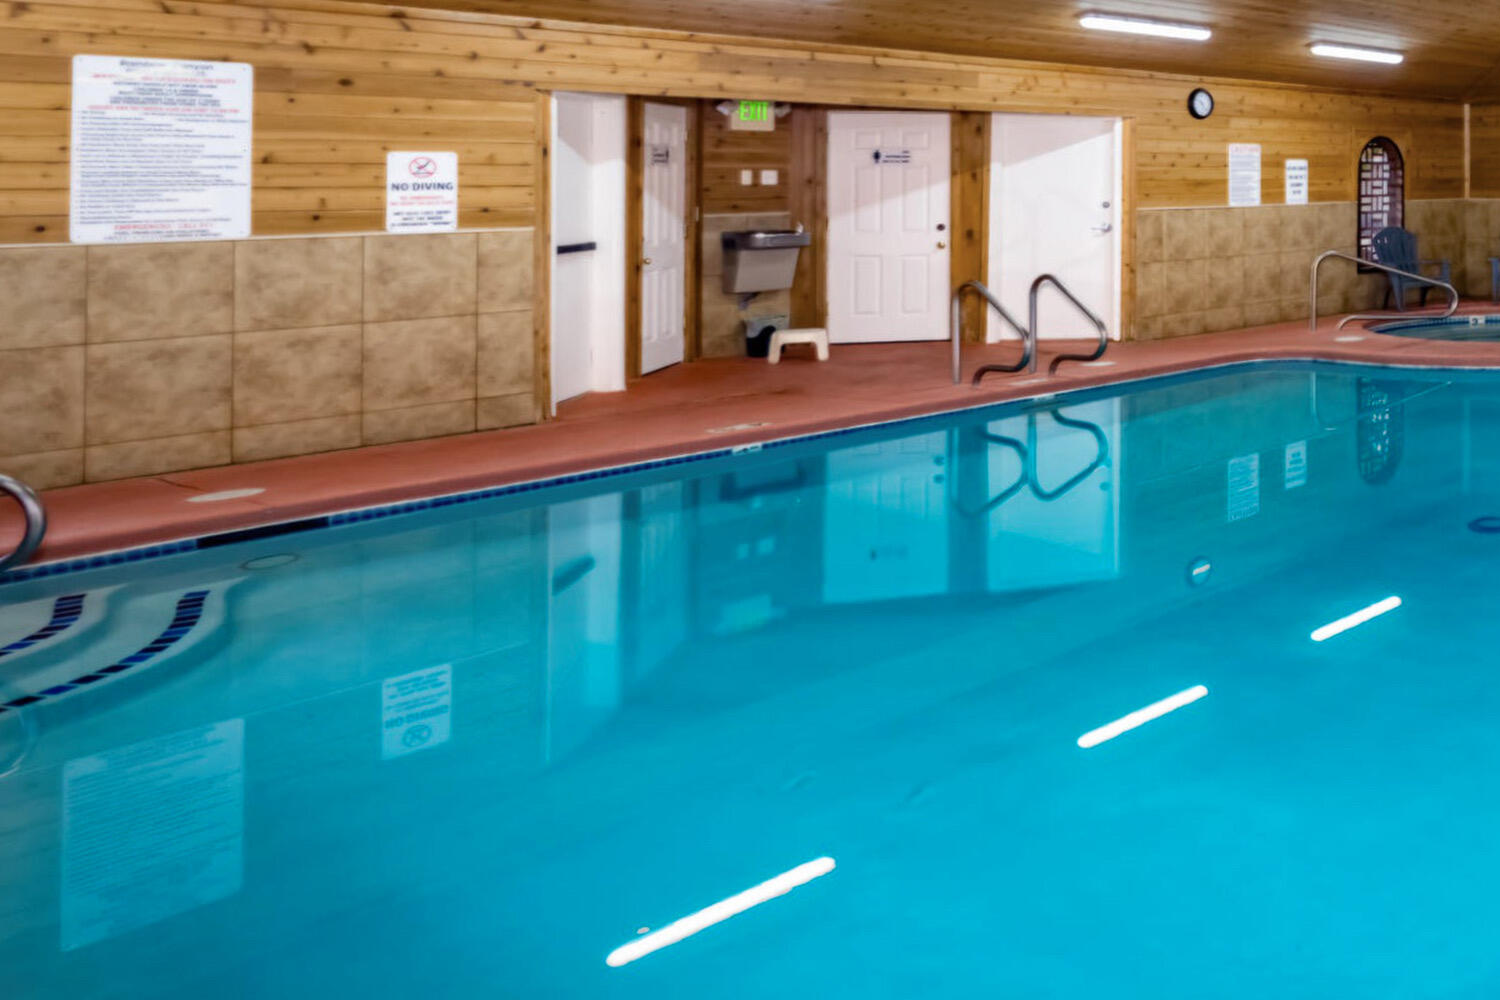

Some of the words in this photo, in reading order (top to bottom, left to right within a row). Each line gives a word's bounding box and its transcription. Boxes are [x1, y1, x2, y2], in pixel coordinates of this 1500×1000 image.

[739, 101, 768, 120] EXIT
[391, 182, 409, 191] NO
[412, 182, 454, 191] DIVING
